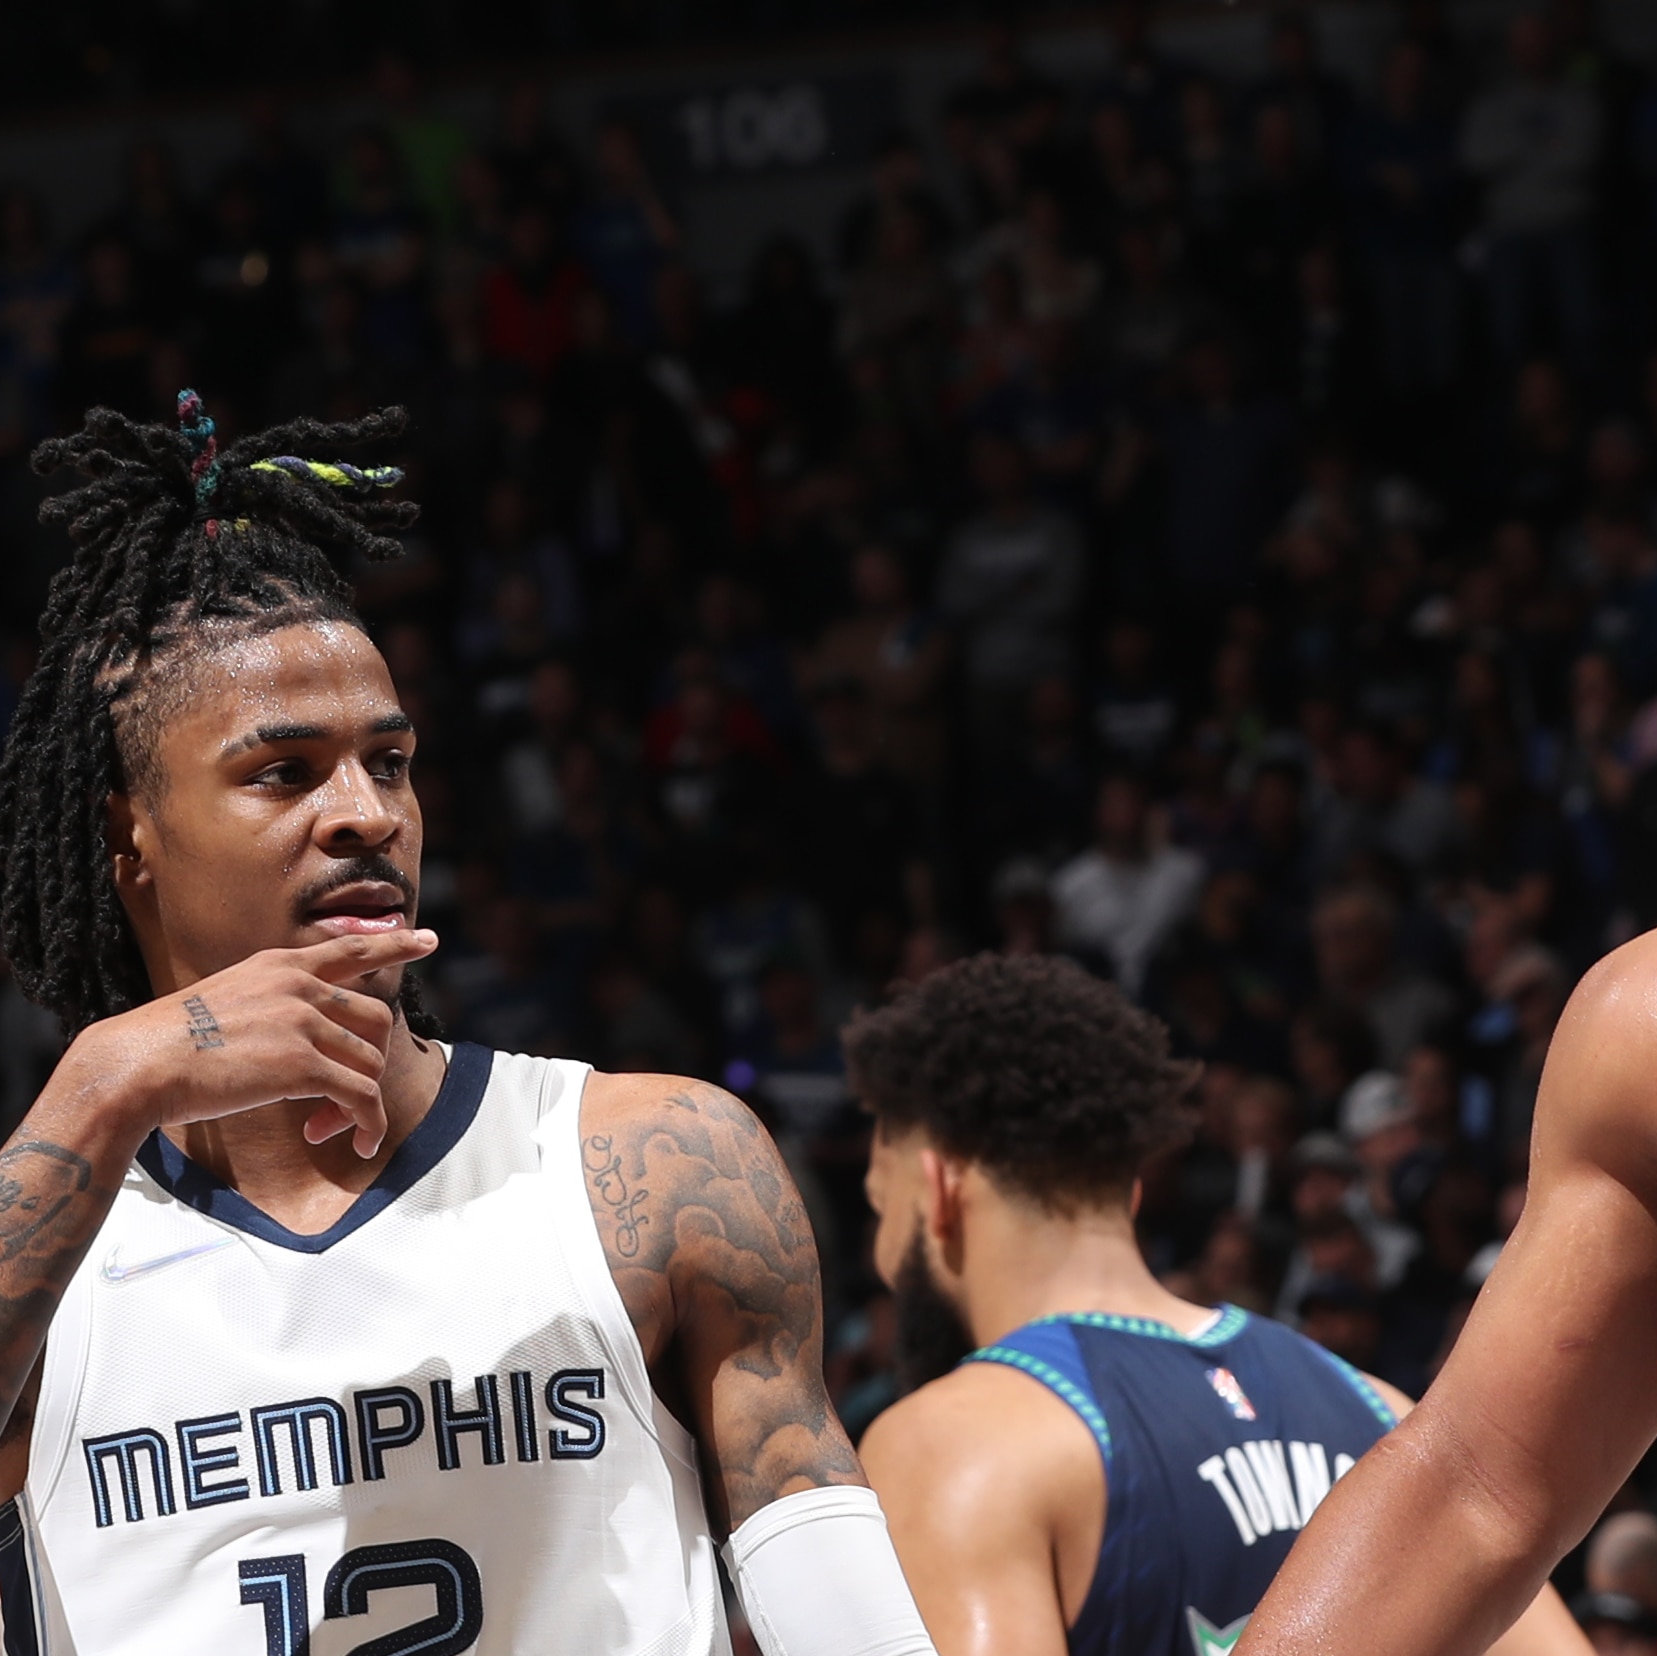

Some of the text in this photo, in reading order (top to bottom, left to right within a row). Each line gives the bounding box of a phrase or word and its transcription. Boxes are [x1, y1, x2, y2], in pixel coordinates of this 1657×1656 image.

[674, 82, 829, 172] 106
[81, 1368, 606, 1528] MEMPHIS
[1197, 1439, 1357, 1546] TOWN
